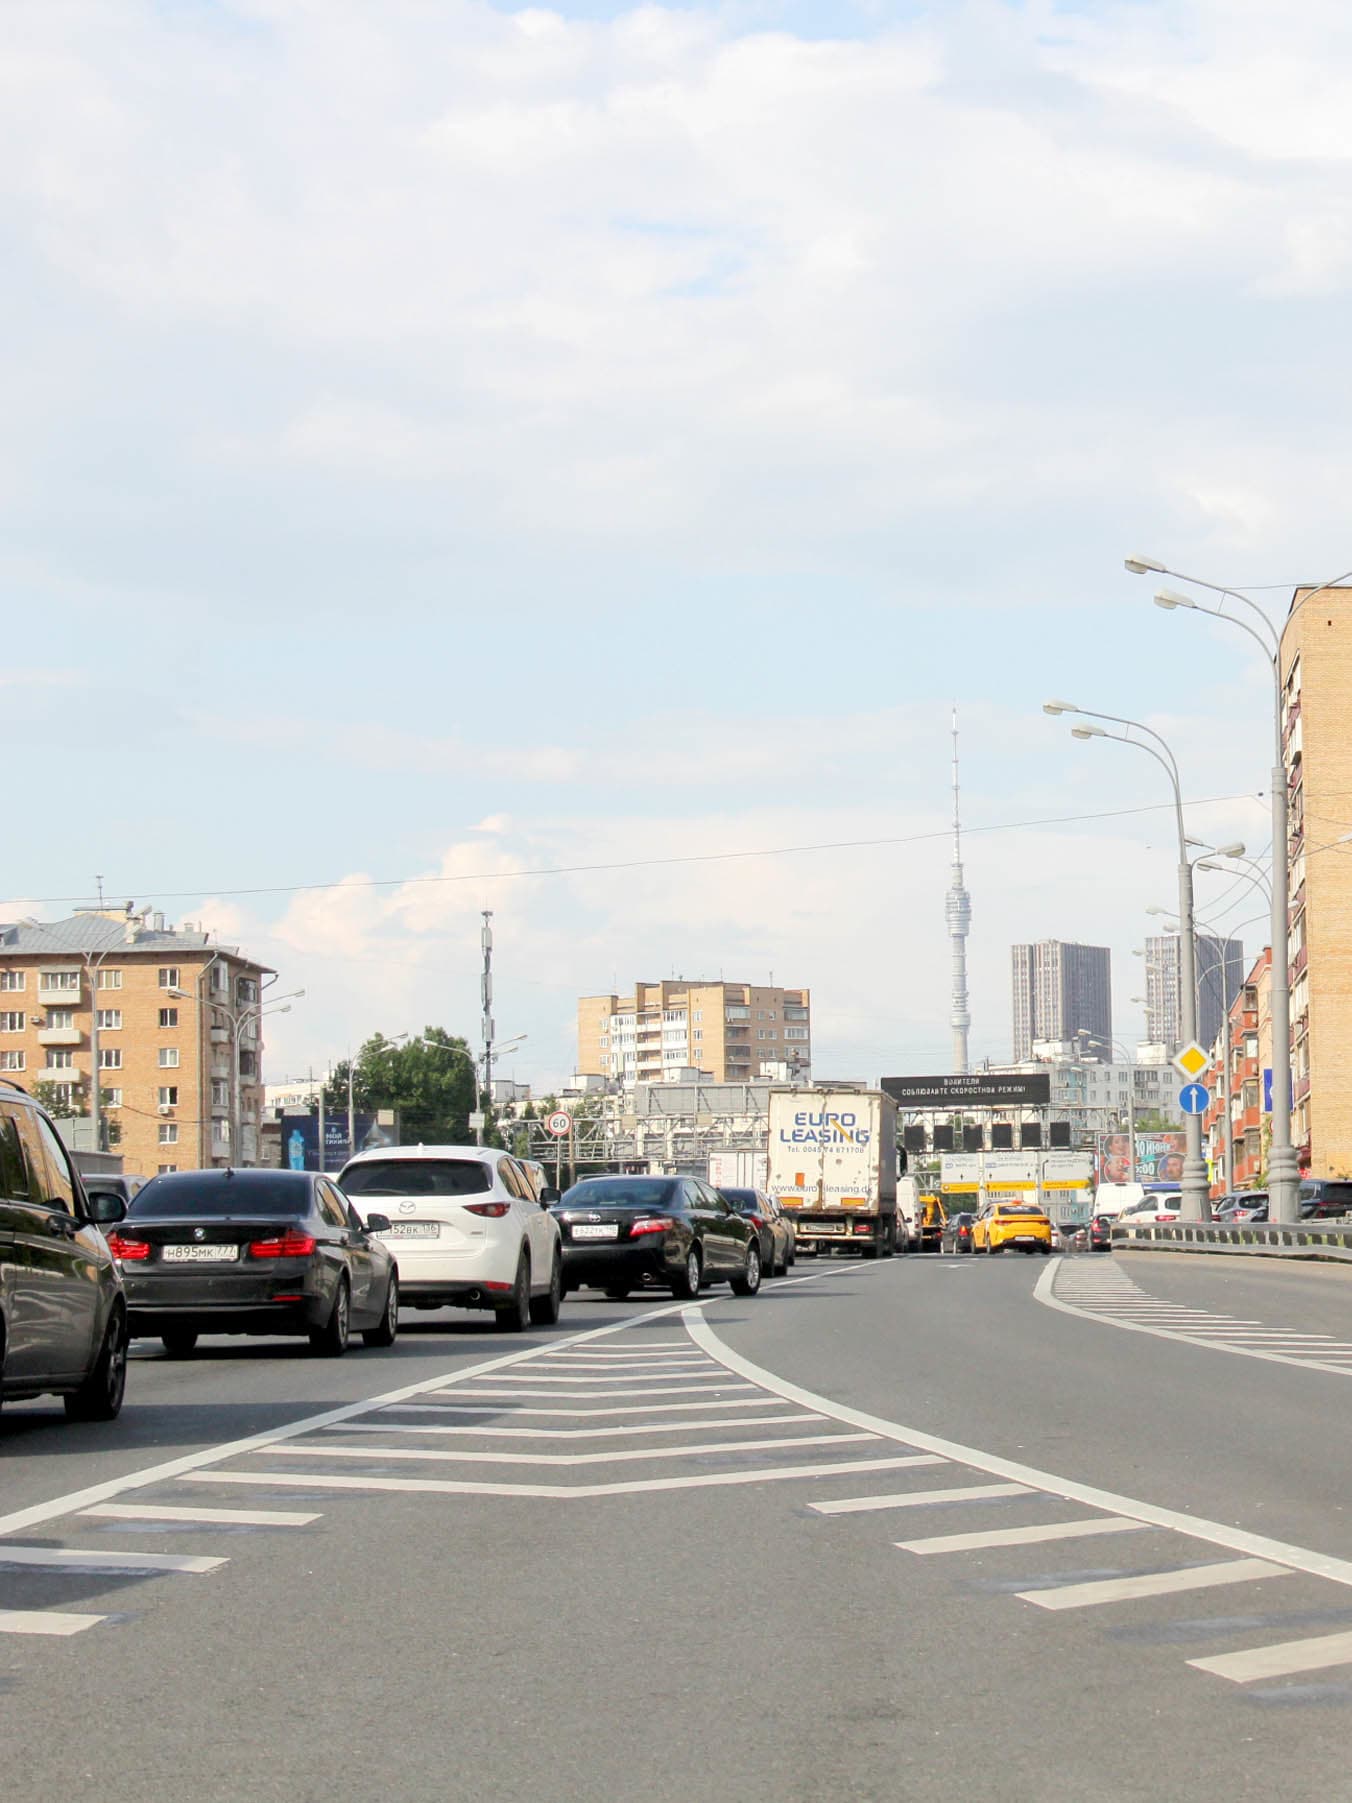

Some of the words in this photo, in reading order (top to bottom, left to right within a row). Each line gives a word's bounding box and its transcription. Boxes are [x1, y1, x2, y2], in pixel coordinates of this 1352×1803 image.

[553, 1118, 566, 1128] 60
[794, 1112, 857, 1127] EURO
[780, 1128, 871, 1144] LEASING
[167, 1246, 214, 1258] Н895МК
